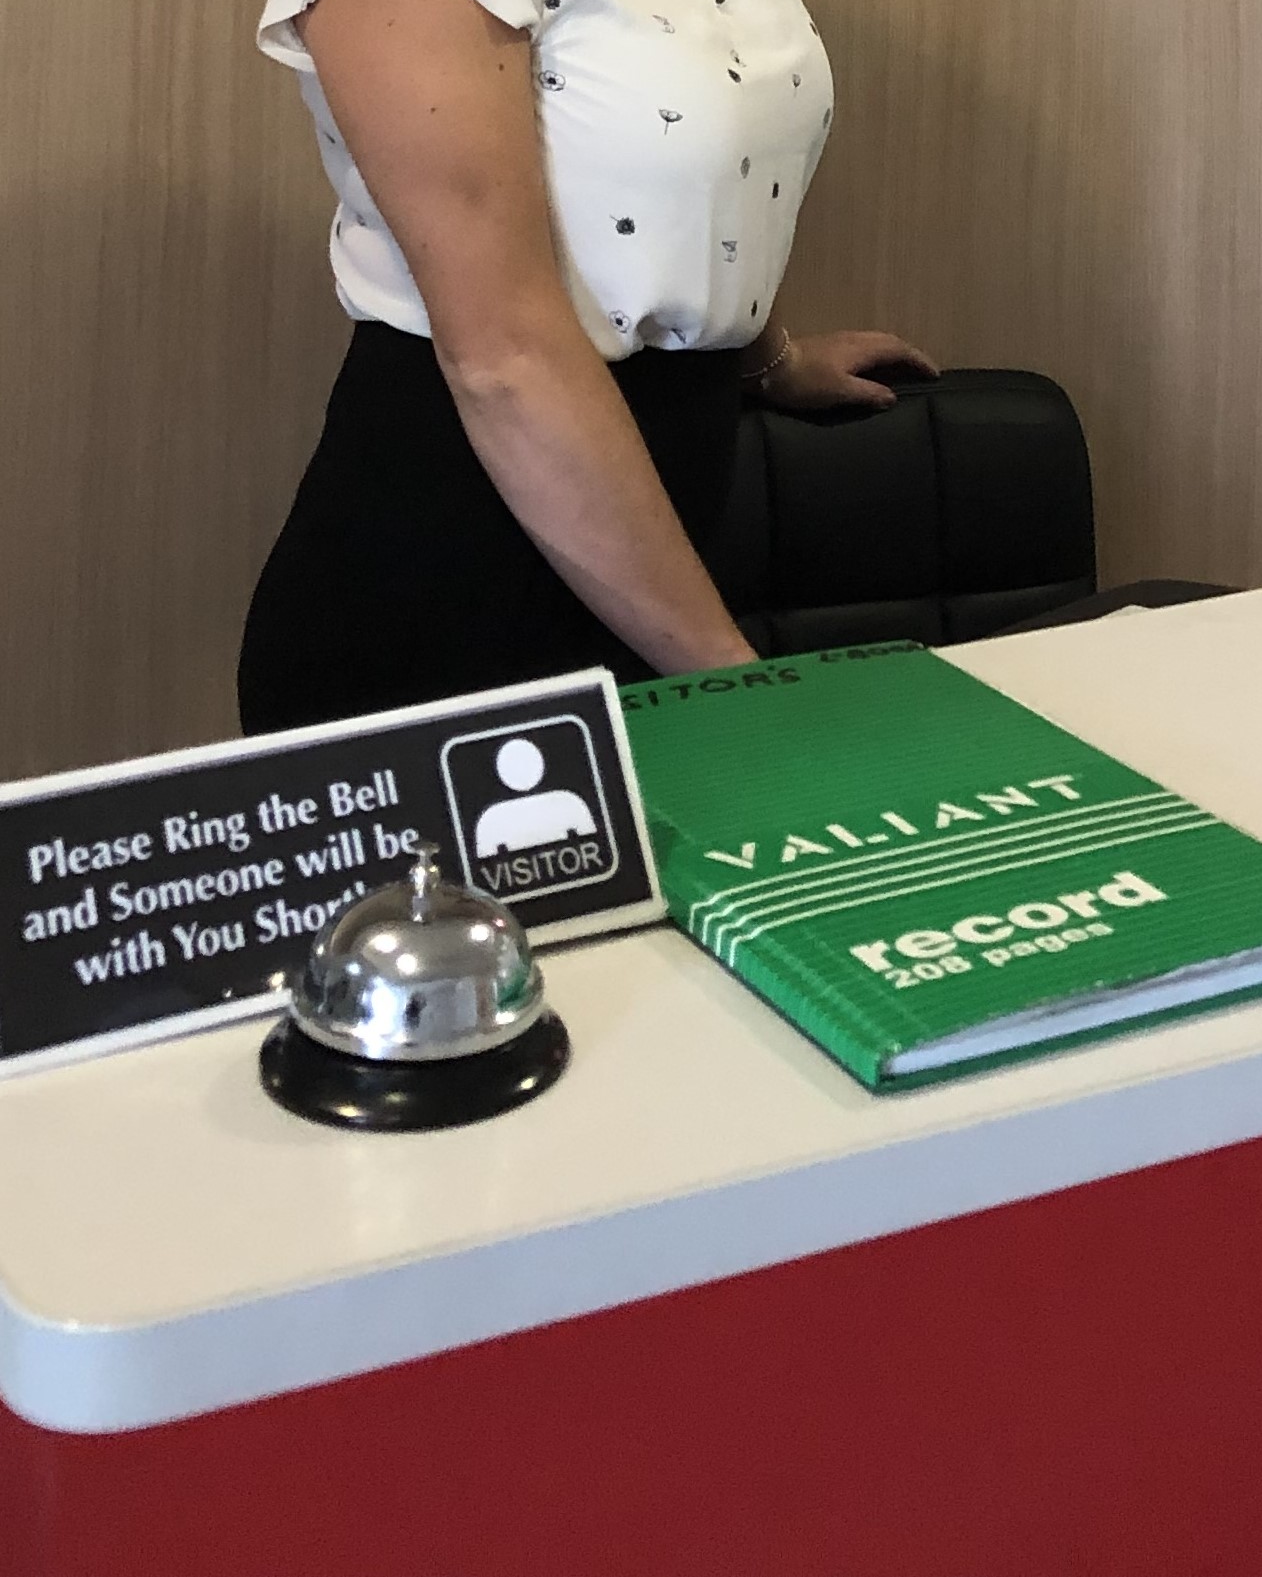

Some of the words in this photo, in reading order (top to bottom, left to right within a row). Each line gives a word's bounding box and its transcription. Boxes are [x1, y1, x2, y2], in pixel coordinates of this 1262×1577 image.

[27, 835, 153, 885] Please
[162, 810, 251, 853] Ring
[257, 792, 319, 835] the
[328, 768, 399, 818] Bell
[480, 841, 604, 892] VISITOR
[703, 773, 1083, 871] VALIANT
[22, 886, 99, 943] and
[108, 858, 285, 922] Someone
[295, 827, 366, 878] will
[373, 823, 420, 860] be
[849, 870, 1169, 974] record
[73, 928, 168, 986] with
[171, 920, 246, 961] You
[884, 954, 974, 990] 208
[981, 922, 1116, 968] pages
